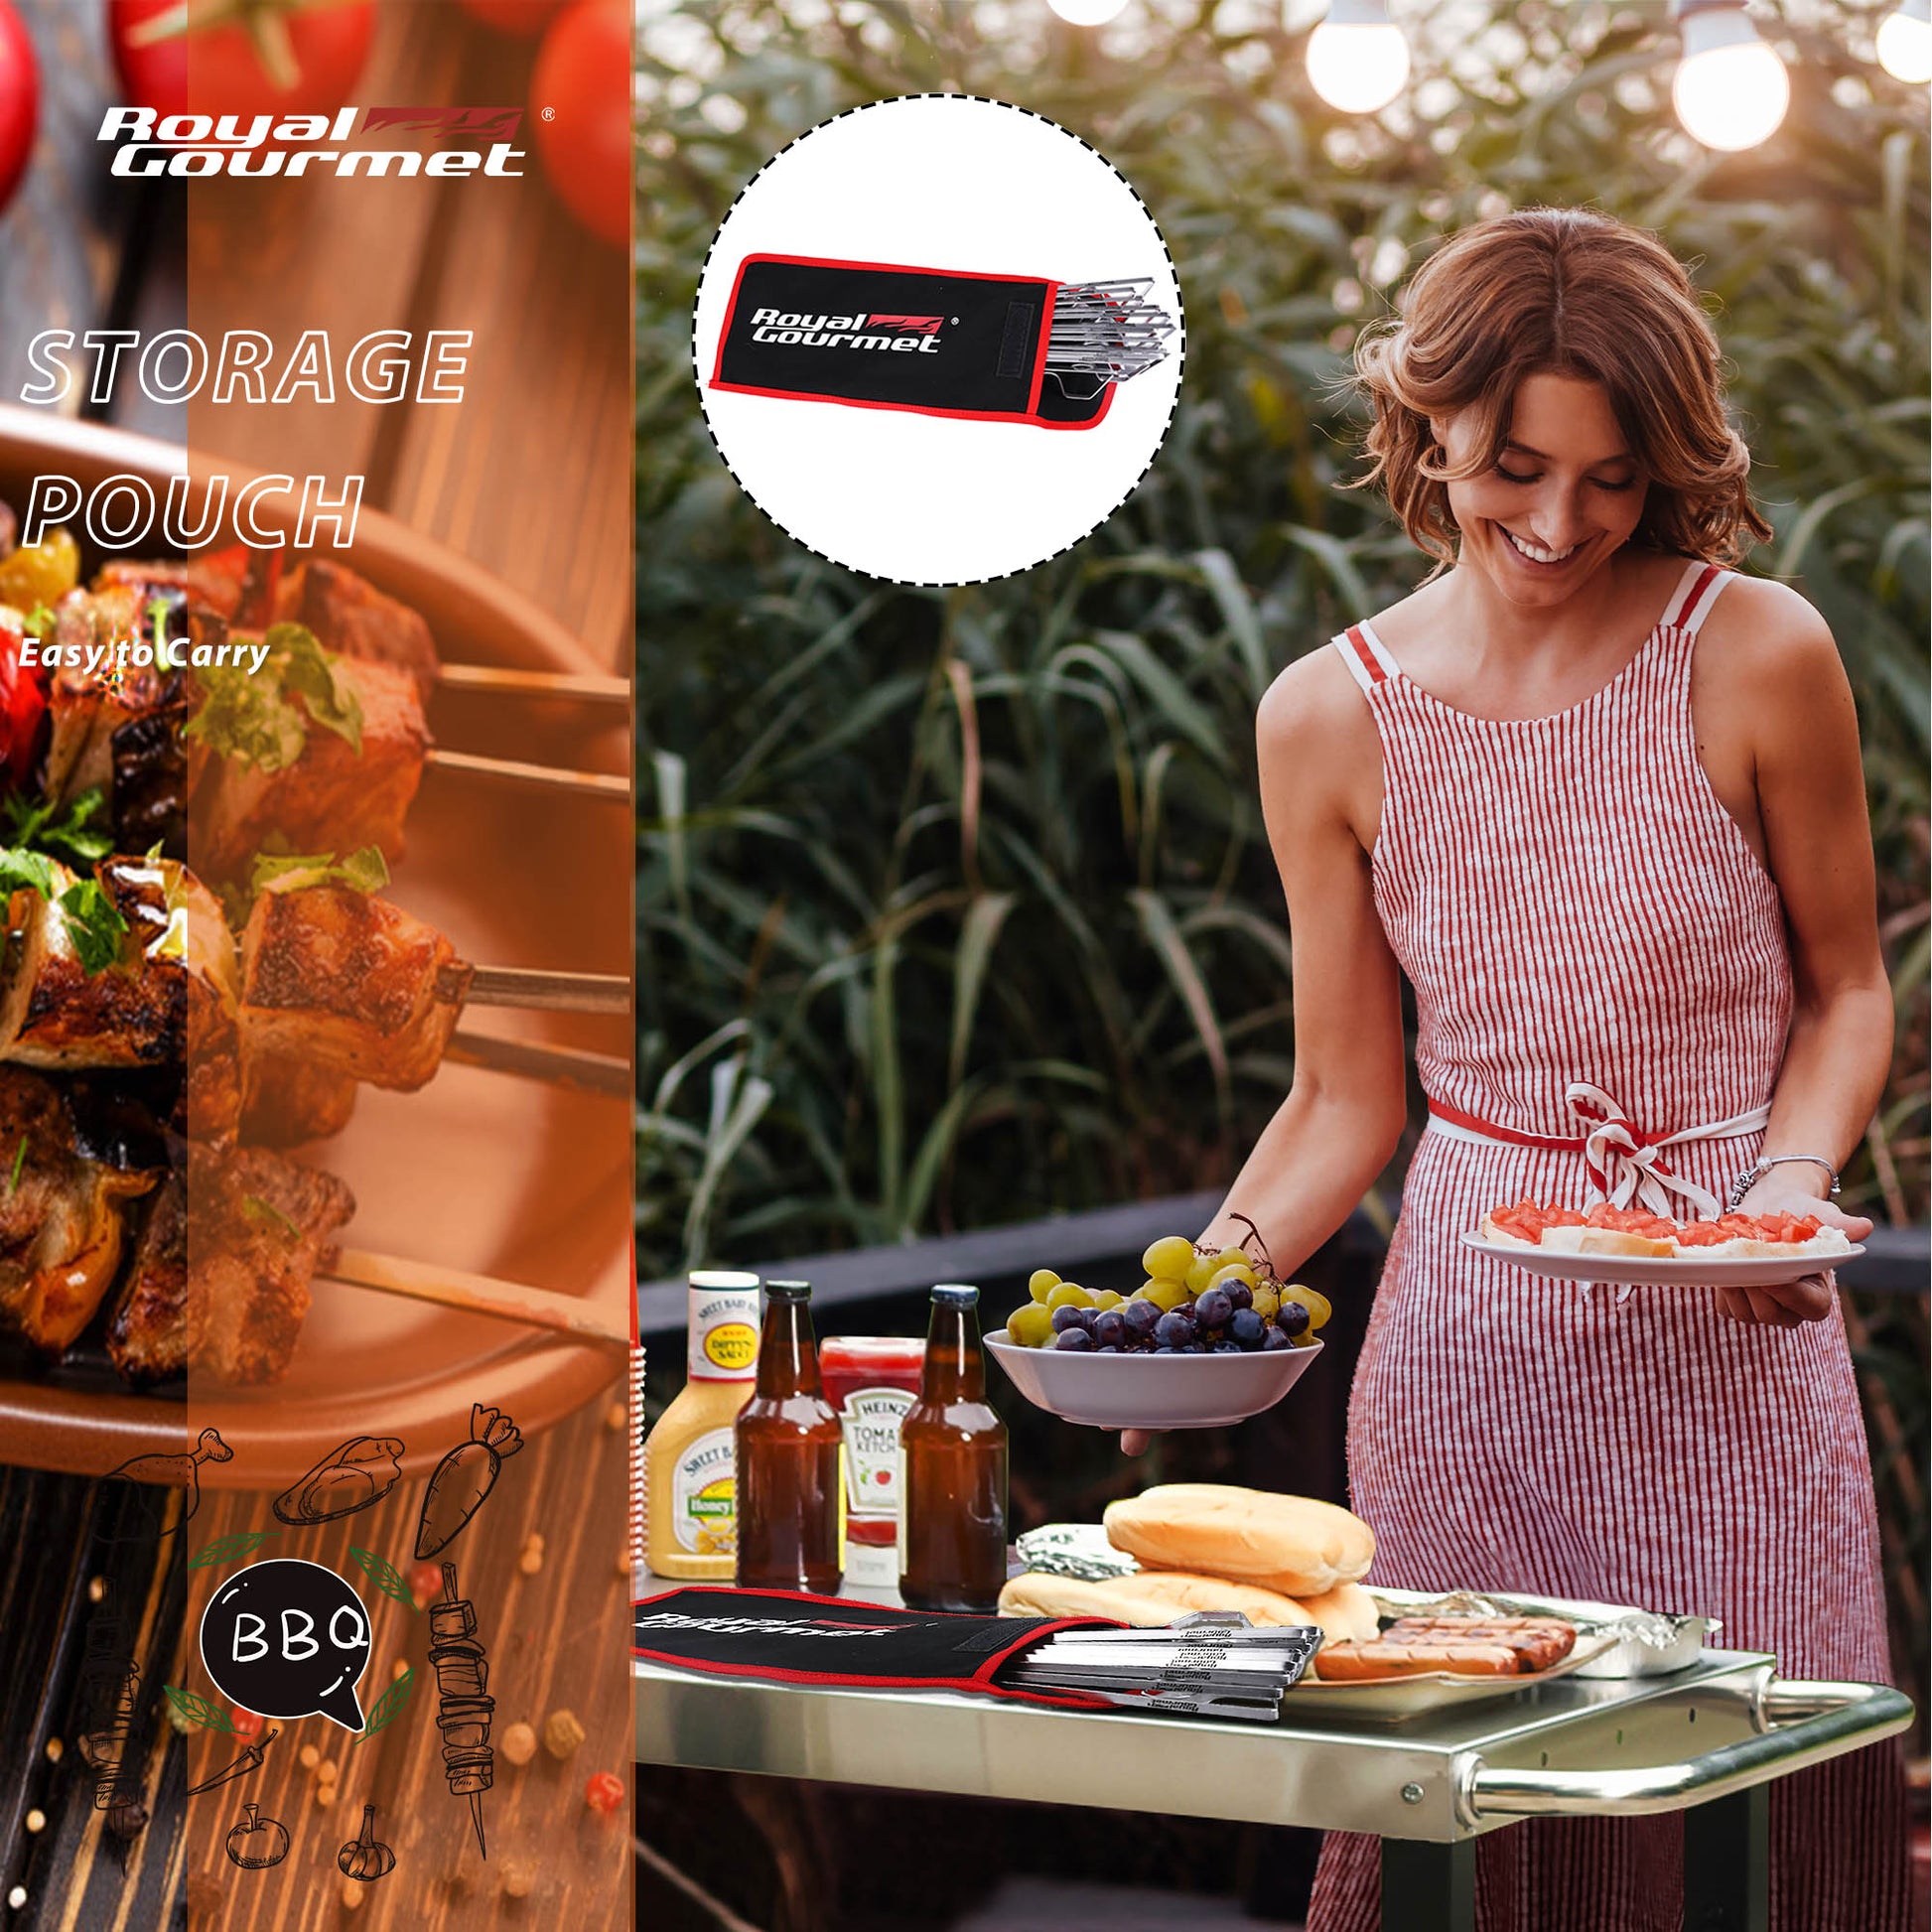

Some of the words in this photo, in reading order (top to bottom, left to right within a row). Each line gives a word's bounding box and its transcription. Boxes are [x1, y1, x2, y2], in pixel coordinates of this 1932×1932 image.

[751, 308, 867, 332] Royal
[753, 326, 941, 352] Gourmet
[862, 1401, 907, 1417] HEINZ
[854, 1426, 896, 1441] TOMA
[857, 1443, 897, 1453] KETCH
[683, 1447, 720, 1477] SWEET
